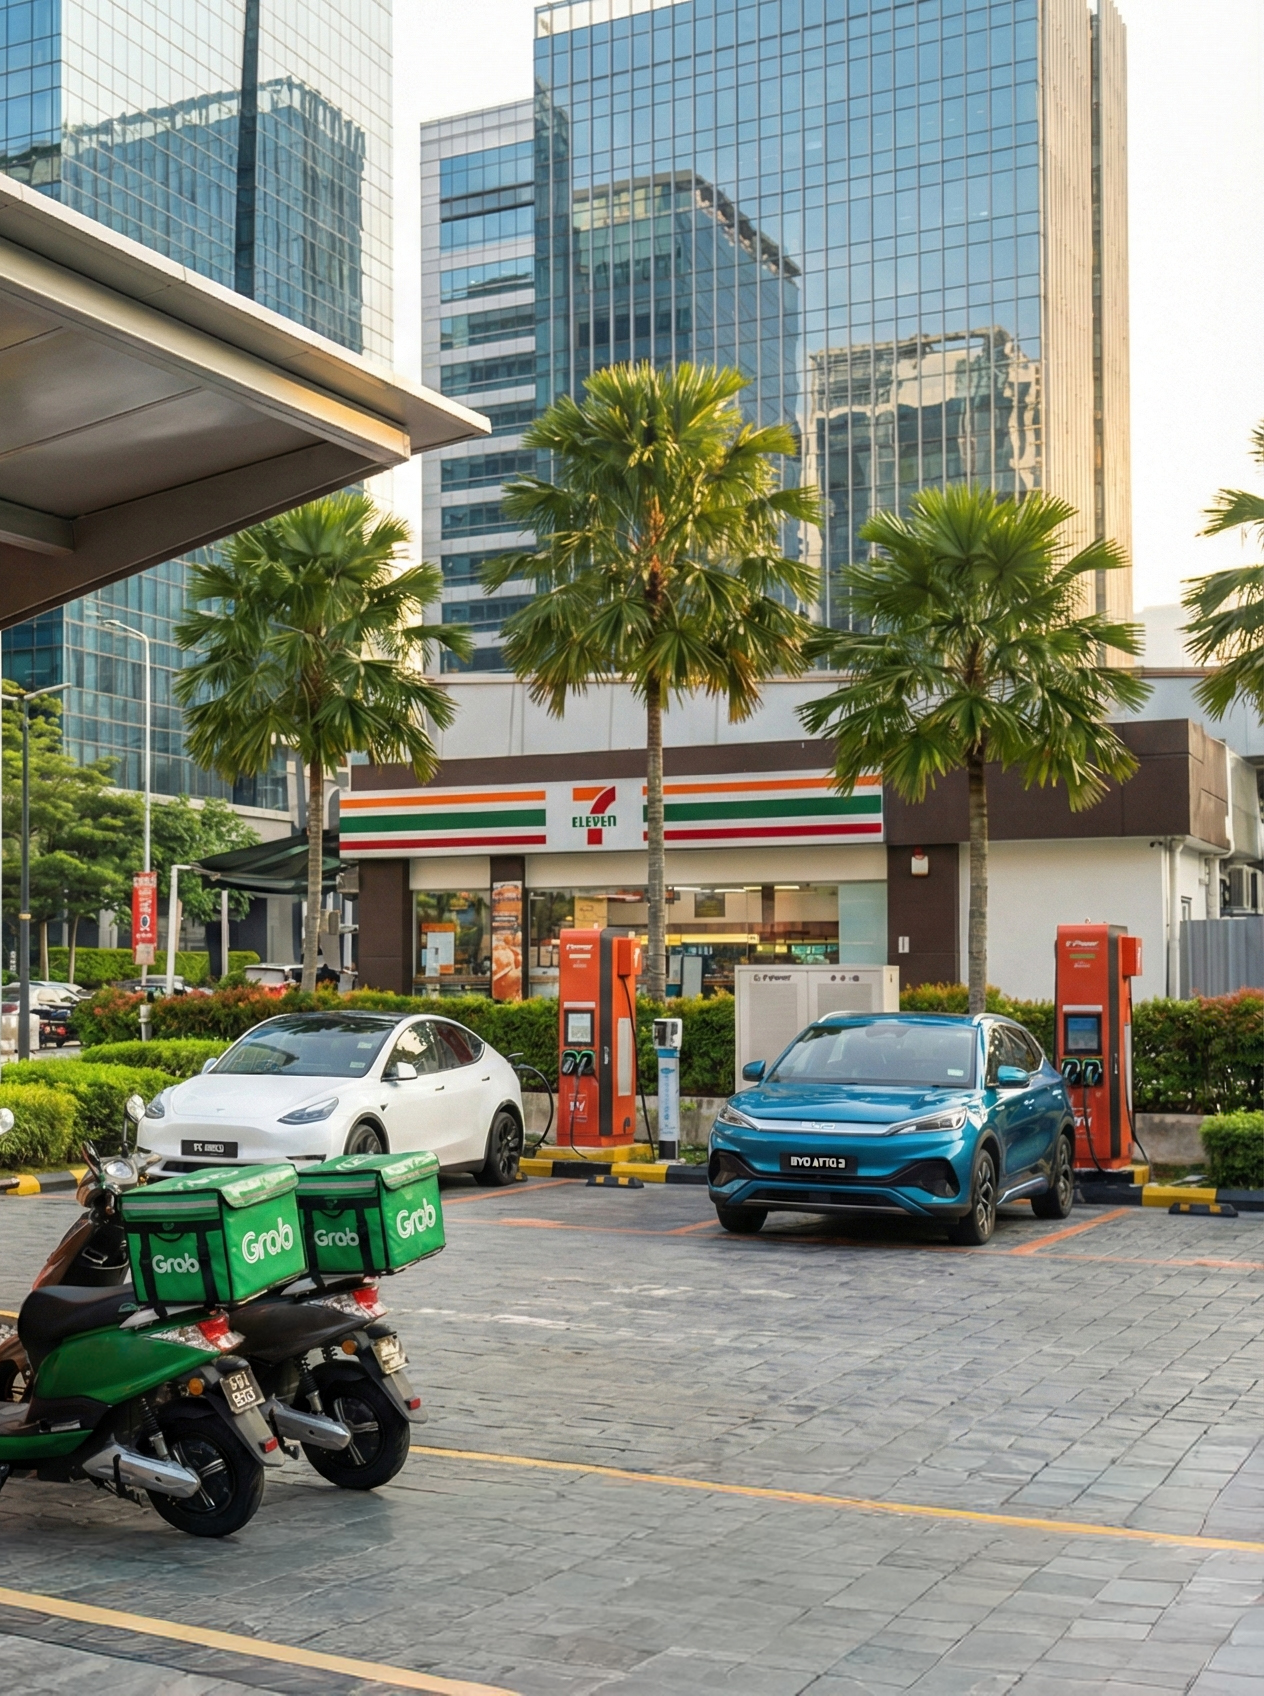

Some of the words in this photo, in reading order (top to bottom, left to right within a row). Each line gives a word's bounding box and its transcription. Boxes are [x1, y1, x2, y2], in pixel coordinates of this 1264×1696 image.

[572, 785, 616, 845] 7
[313, 1227, 360, 1247] Grab
[396, 1198, 436, 1239] Grab
[241, 1217, 294, 1264] Grab
[152, 1253, 200, 1274] Grab
